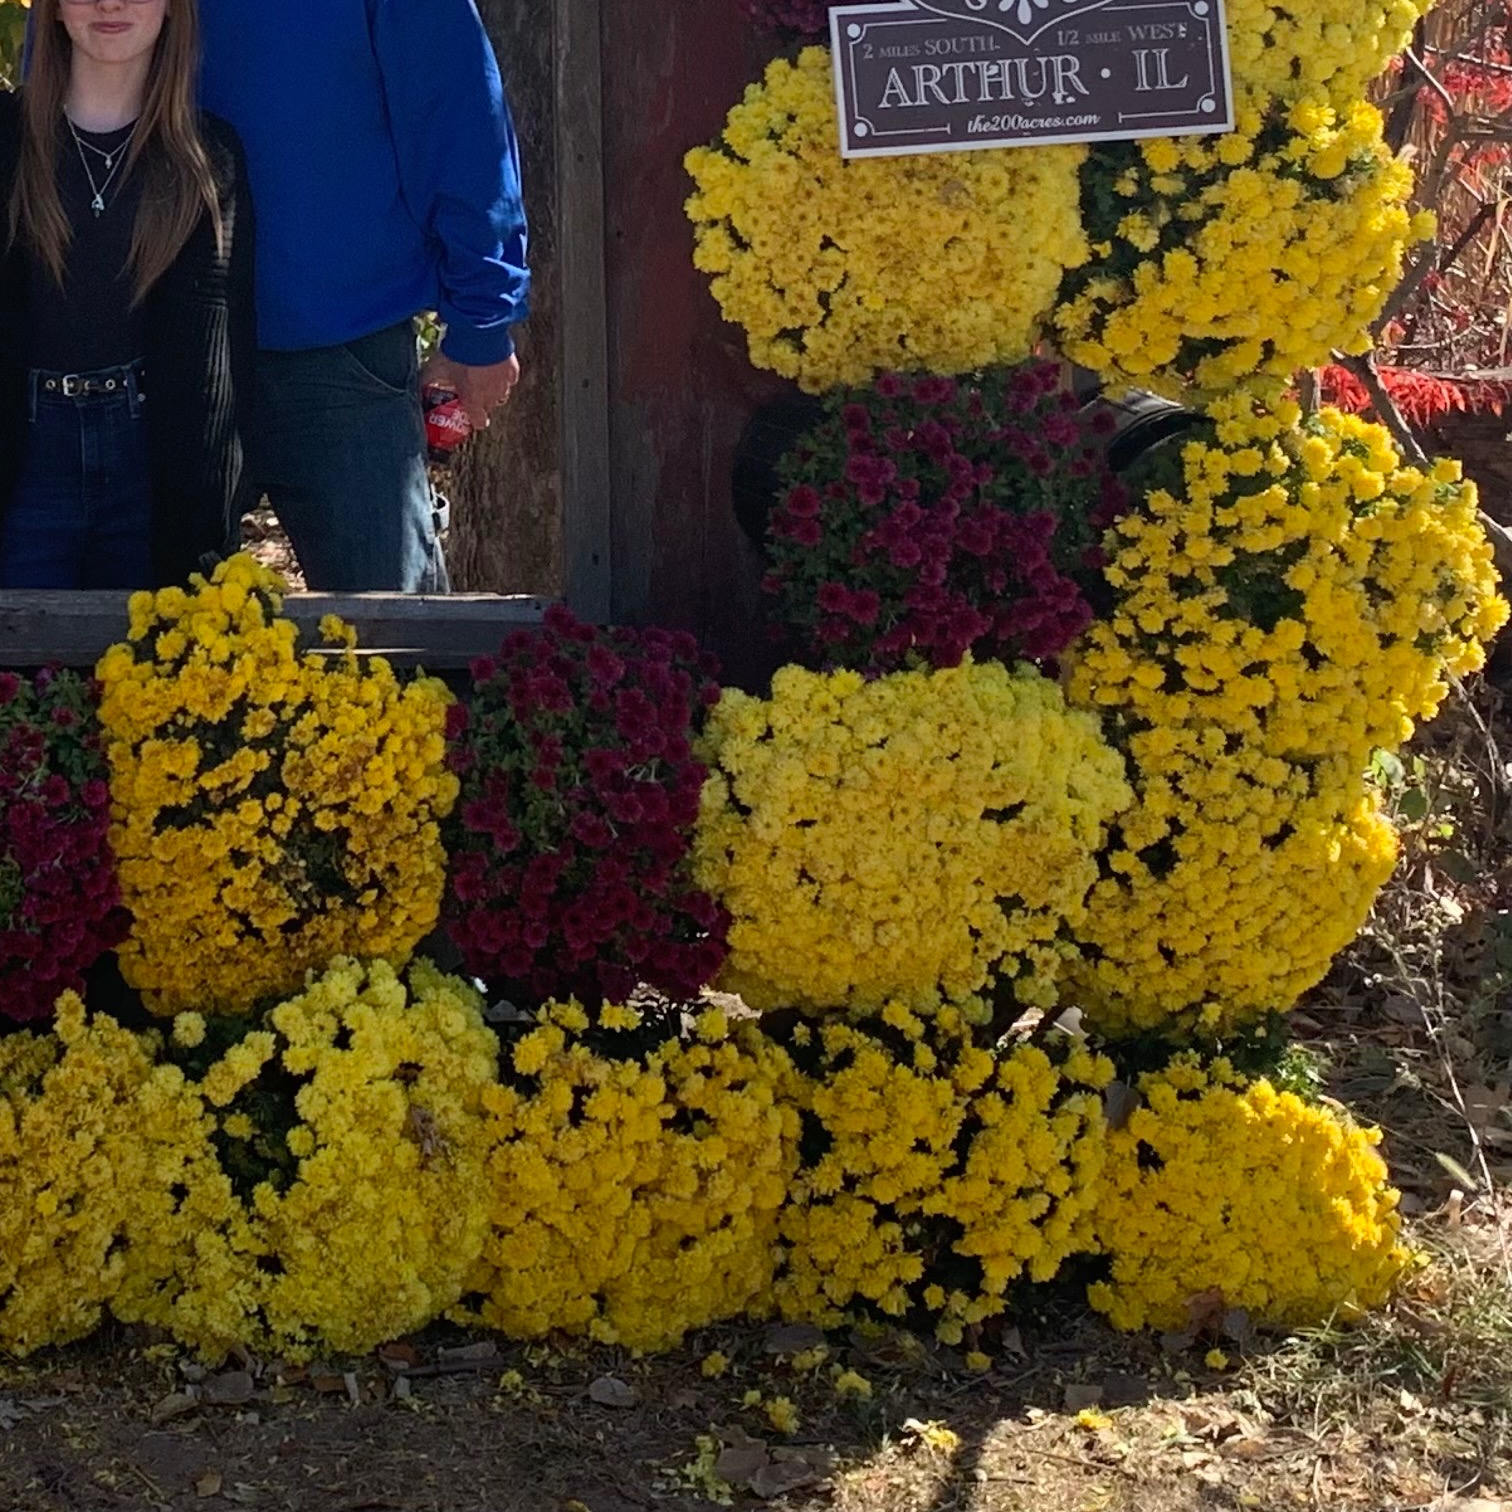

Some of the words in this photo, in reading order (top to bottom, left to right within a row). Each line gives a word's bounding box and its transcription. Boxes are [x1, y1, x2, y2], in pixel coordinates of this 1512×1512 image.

[863, 42, 874, 59] 2
[878, 54, 1089, 109] ARTHUR
[1132, 47, 1188, 91] IL
[967, 111, 1101, 134] the200acres.com
